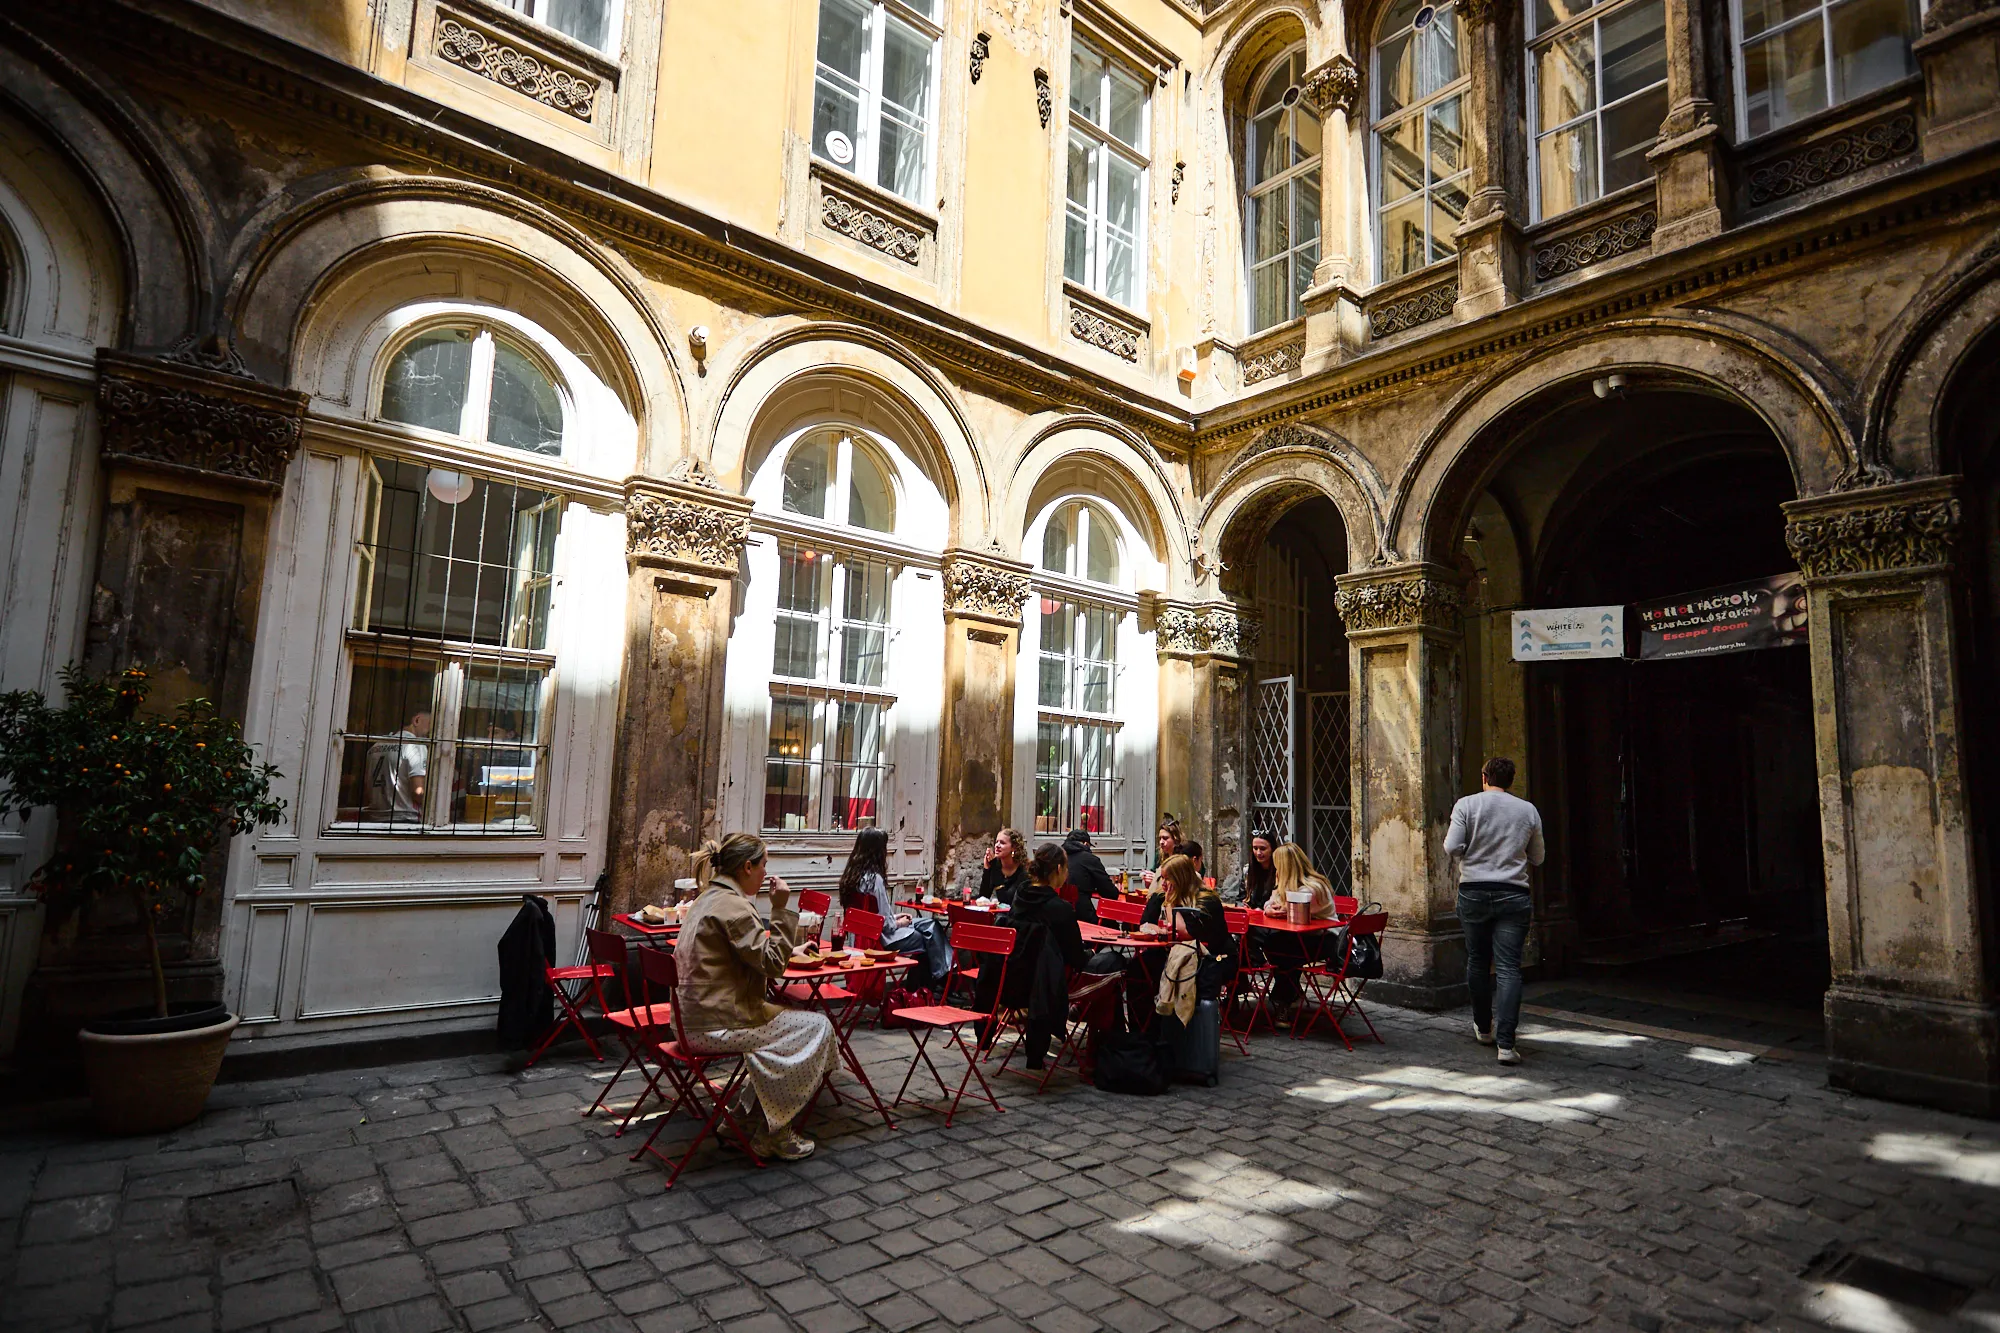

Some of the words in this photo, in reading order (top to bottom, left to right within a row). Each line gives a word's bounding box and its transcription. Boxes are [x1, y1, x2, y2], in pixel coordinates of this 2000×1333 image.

[1663, 629, 1708, 640] Escape
[1712, 622, 1748, 633] Room
[1665, 642, 1746, 657] www.horrorfactory.hu
[372, 755, 386, 787] 4
